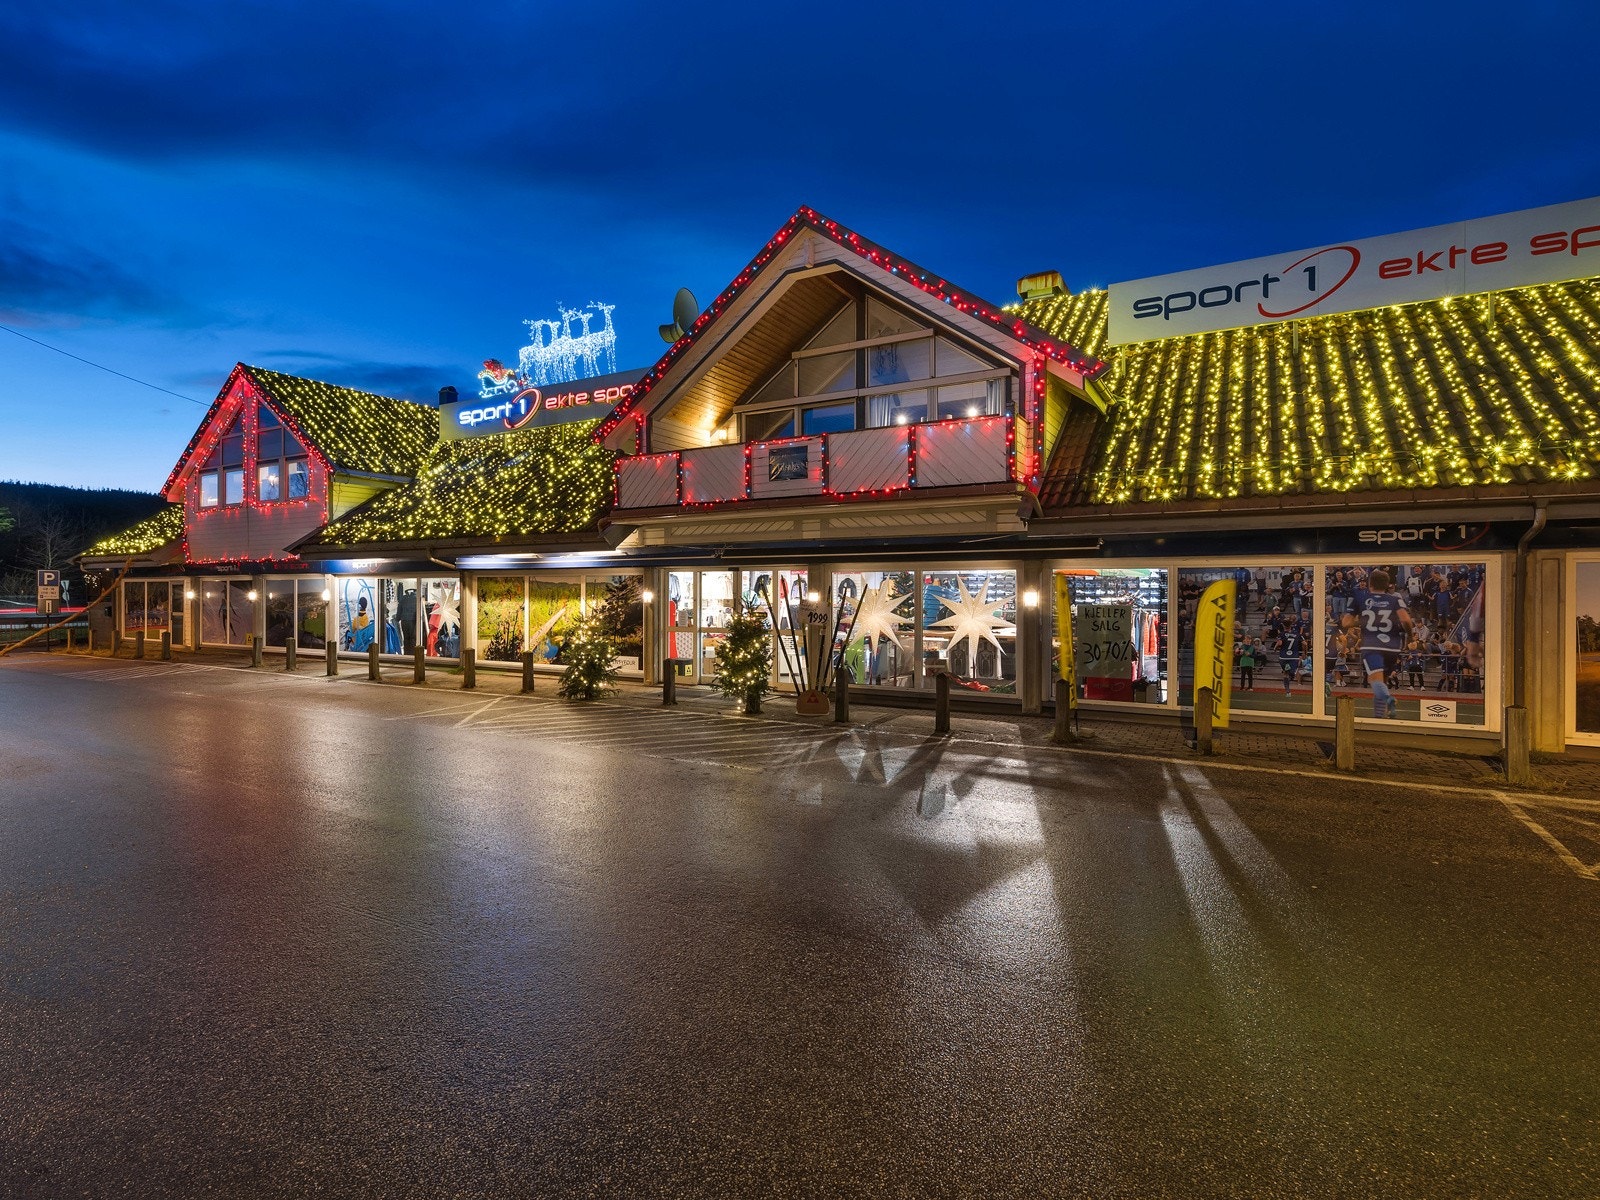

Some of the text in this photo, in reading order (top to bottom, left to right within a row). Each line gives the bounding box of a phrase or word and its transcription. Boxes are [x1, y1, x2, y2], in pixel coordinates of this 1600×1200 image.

[1132, 273, 1281, 321] sport
[1302, 265, 1317, 292] 1
[1378, 241, 1509, 280] ekte
[458, 404, 513, 427] sport
[518, 398, 528, 416] 1
[544, 391, 591, 411] ekte
[1358, 524, 1467, 545] sport 1
[43, 572, 56, 585] P
[807, 610, 829, 624] 1999
[1084, 606, 1127, 620] KJELLER
[1361, 609, 1394, 634] 23
[1091, 620, 1121, 632] SALG
[1082, 640, 1129, 665] 30-70%
[1287, 637, 1296, 650] 7
[1211, 612, 1229, 720] FISCHER
